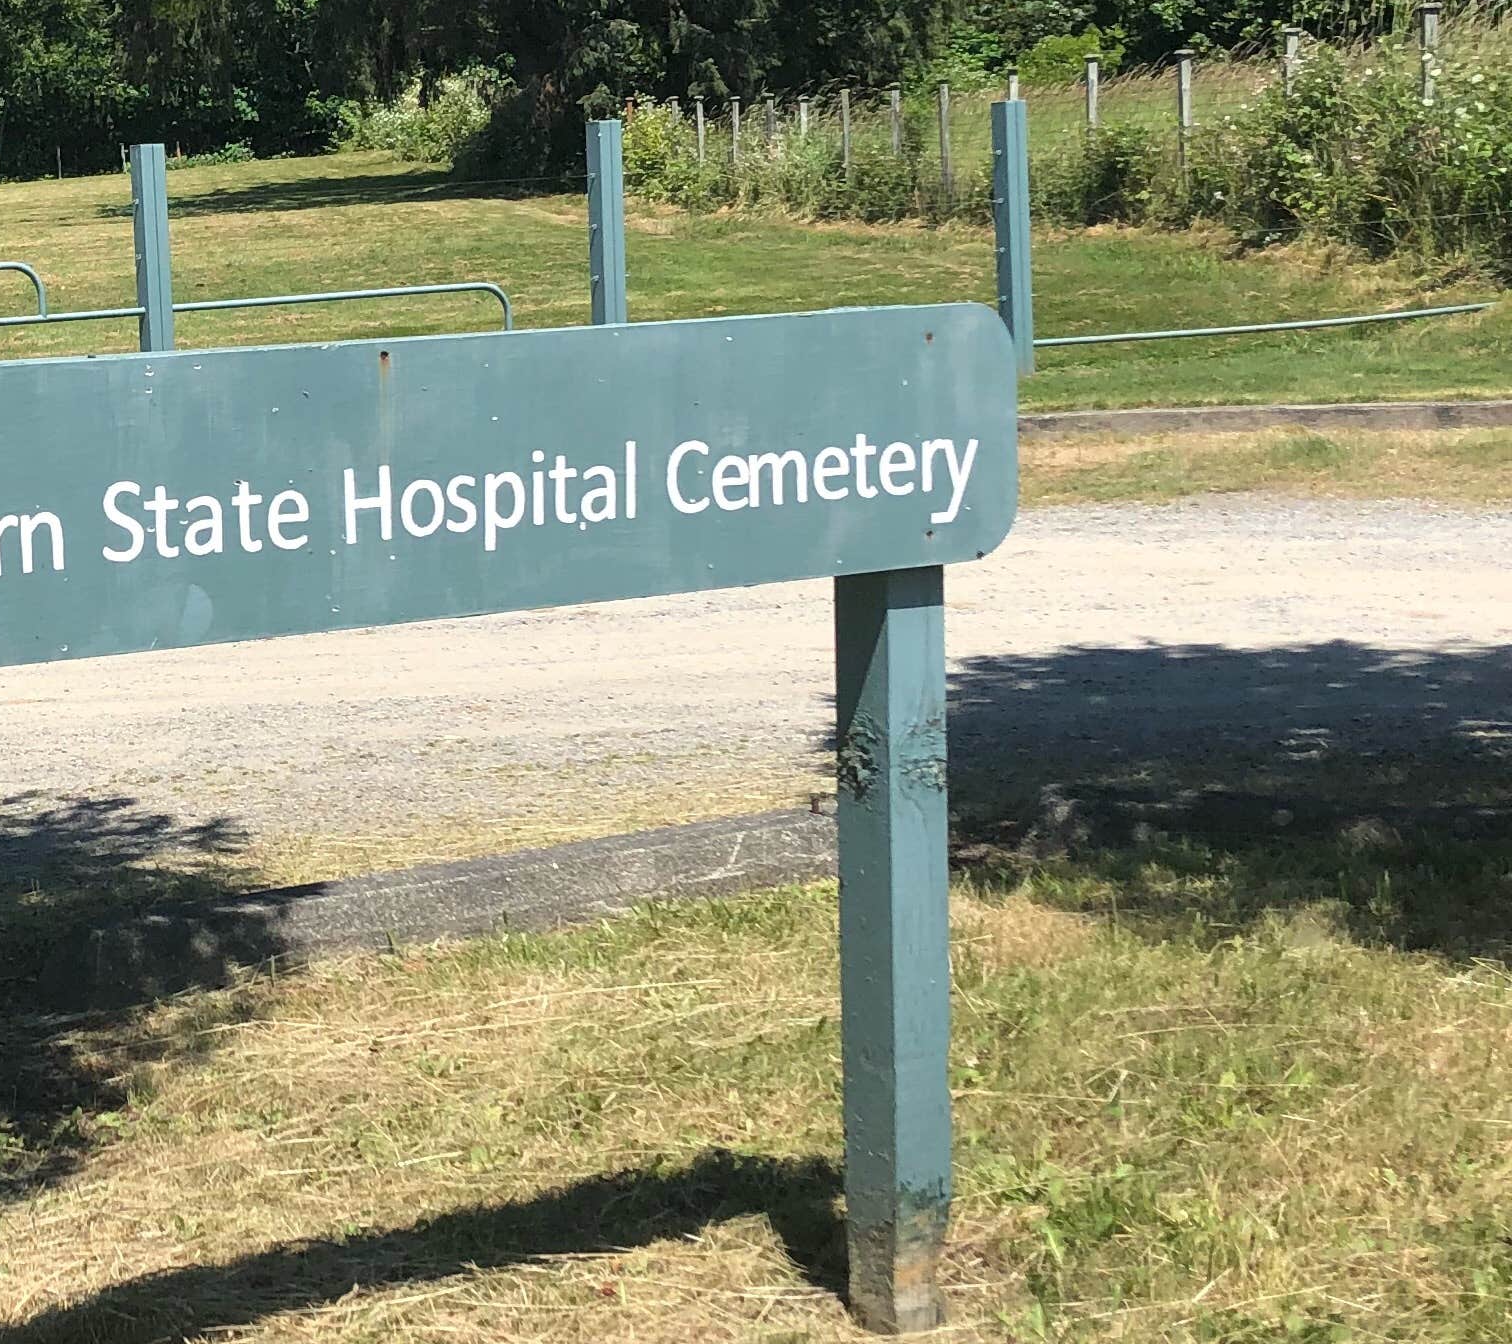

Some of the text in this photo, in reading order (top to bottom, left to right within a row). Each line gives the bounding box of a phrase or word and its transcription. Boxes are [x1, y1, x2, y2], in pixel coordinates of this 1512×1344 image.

[102, 479, 310, 563] State
[343, 440, 637, 552] Hospital
[666, 433, 979, 525] Cemetery
